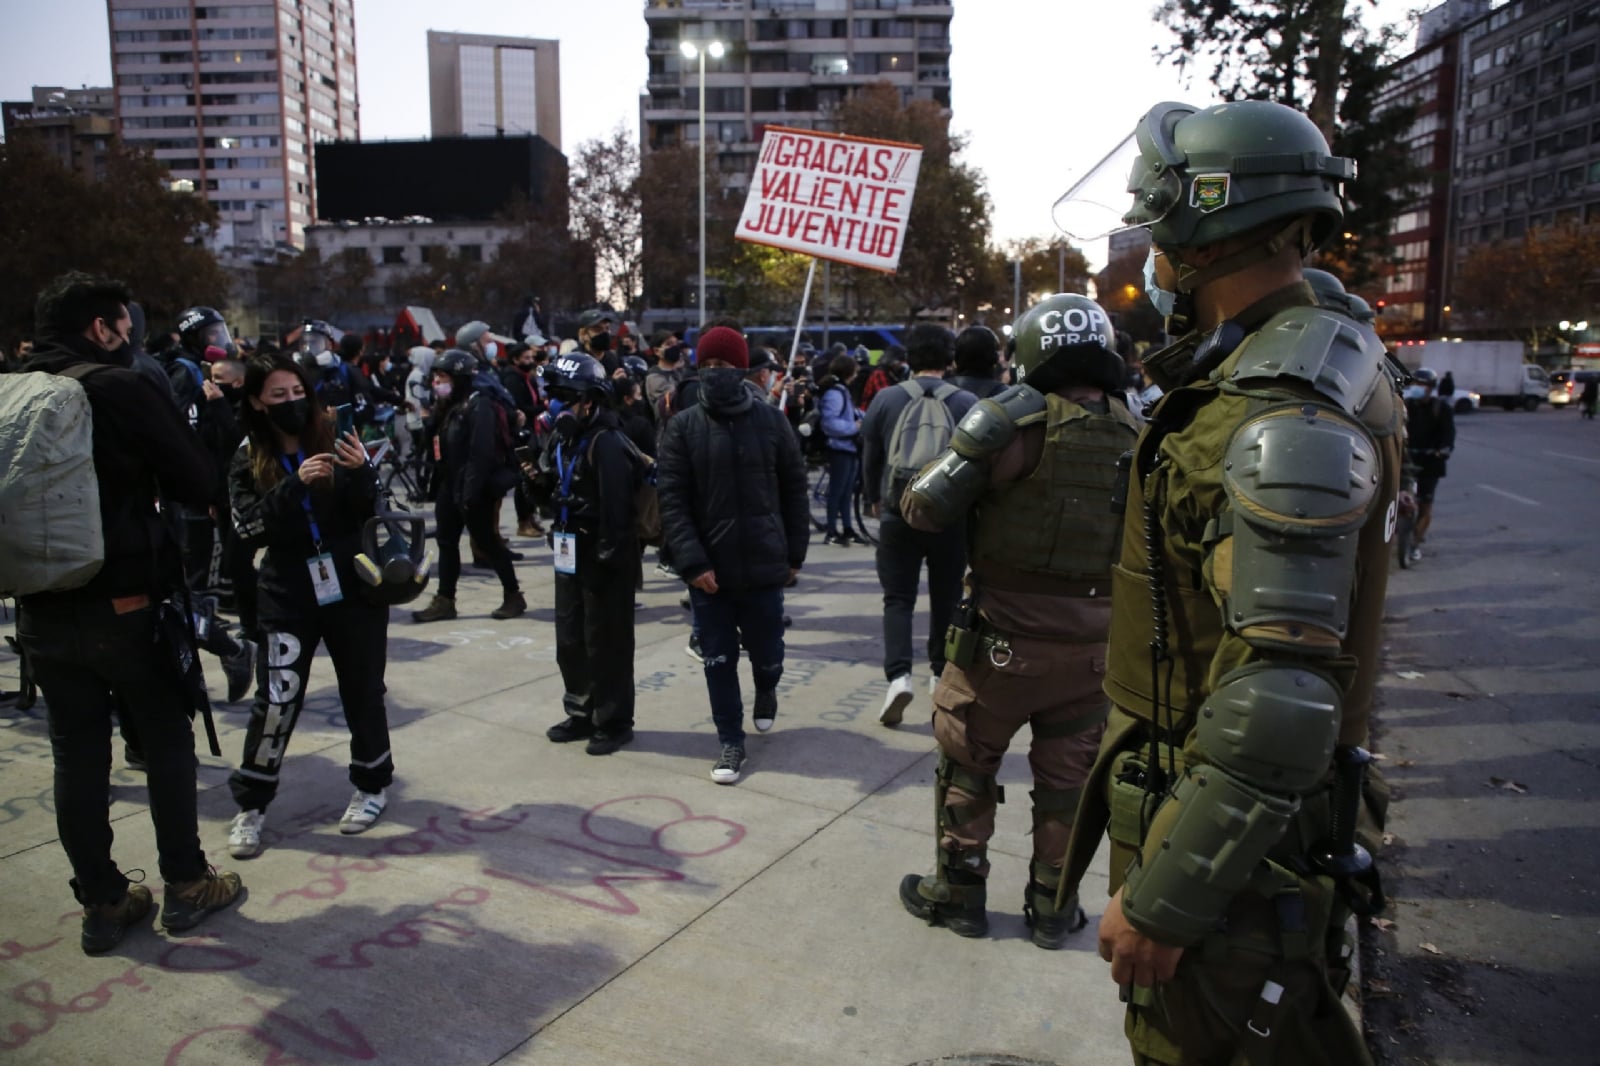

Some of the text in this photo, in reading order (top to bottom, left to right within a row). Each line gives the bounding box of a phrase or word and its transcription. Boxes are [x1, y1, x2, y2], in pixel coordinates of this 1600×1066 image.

[745, 203, 898, 258] JUVENTUD
[1039, 308, 1105, 334] COP
[253, 631, 302, 768] DDHH
